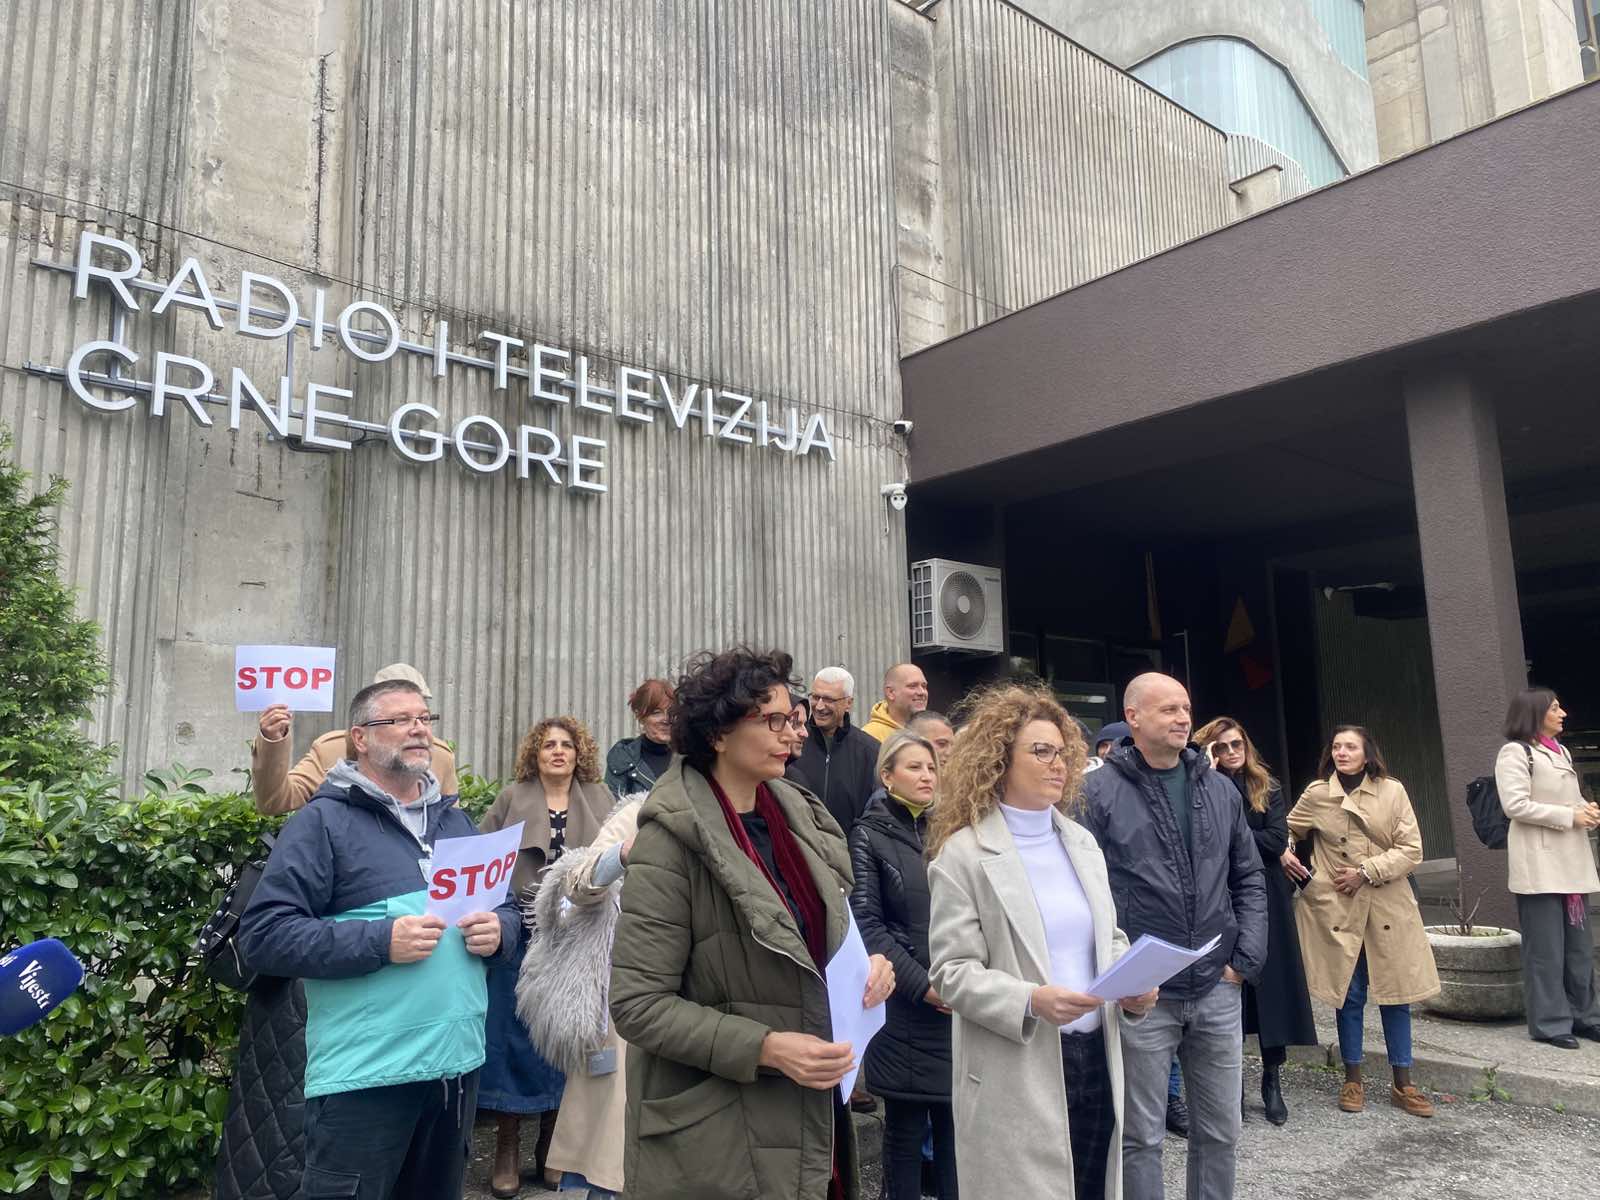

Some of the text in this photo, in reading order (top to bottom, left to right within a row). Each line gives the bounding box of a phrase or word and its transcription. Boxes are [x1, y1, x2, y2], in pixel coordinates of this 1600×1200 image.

[74, 230, 836, 464] RADIO I TELEVIZIJA
[66, 340, 609, 494] CRNE GORE
[237, 667, 333, 690] STOP
[430, 851, 517, 901] STOP
